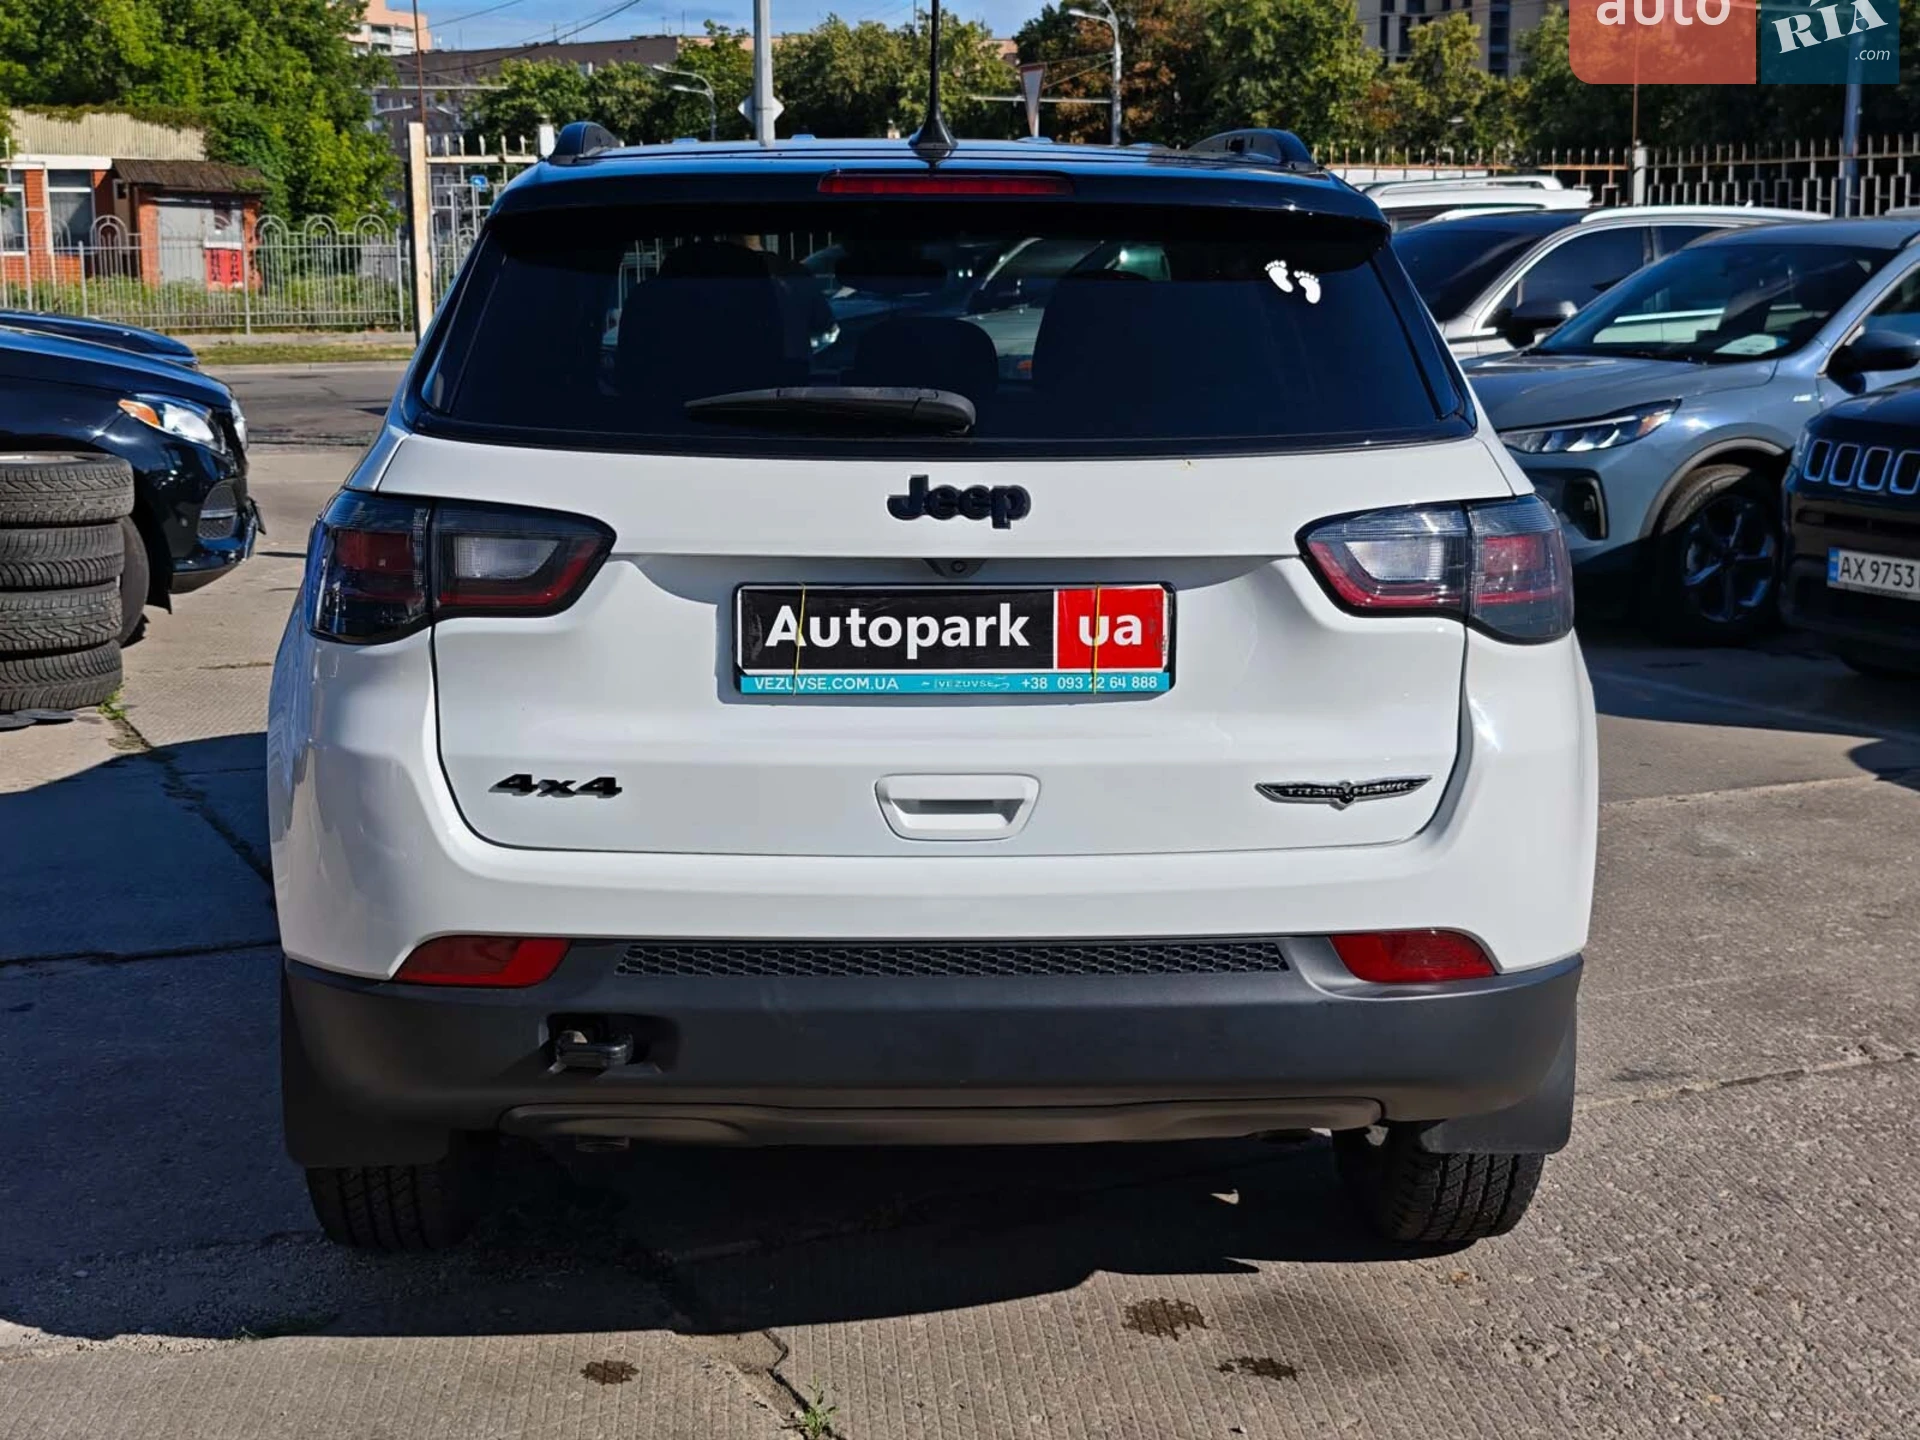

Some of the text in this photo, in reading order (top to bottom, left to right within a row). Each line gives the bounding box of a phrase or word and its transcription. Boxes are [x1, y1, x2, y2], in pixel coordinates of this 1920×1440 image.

[887, 474, 1031, 529] Jeep
[1840, 556, 1915, 588] AX 9753
[764, 603, 1143, 660] Autopark ua
[1022, 676, 1048, 689] +38
[1057, 676, 1083, 690] 093
[1109, 676, 1126, 689] 64
[1131, 675, 1158, 689] 888
[488, 774, 622, 798] 4x4
